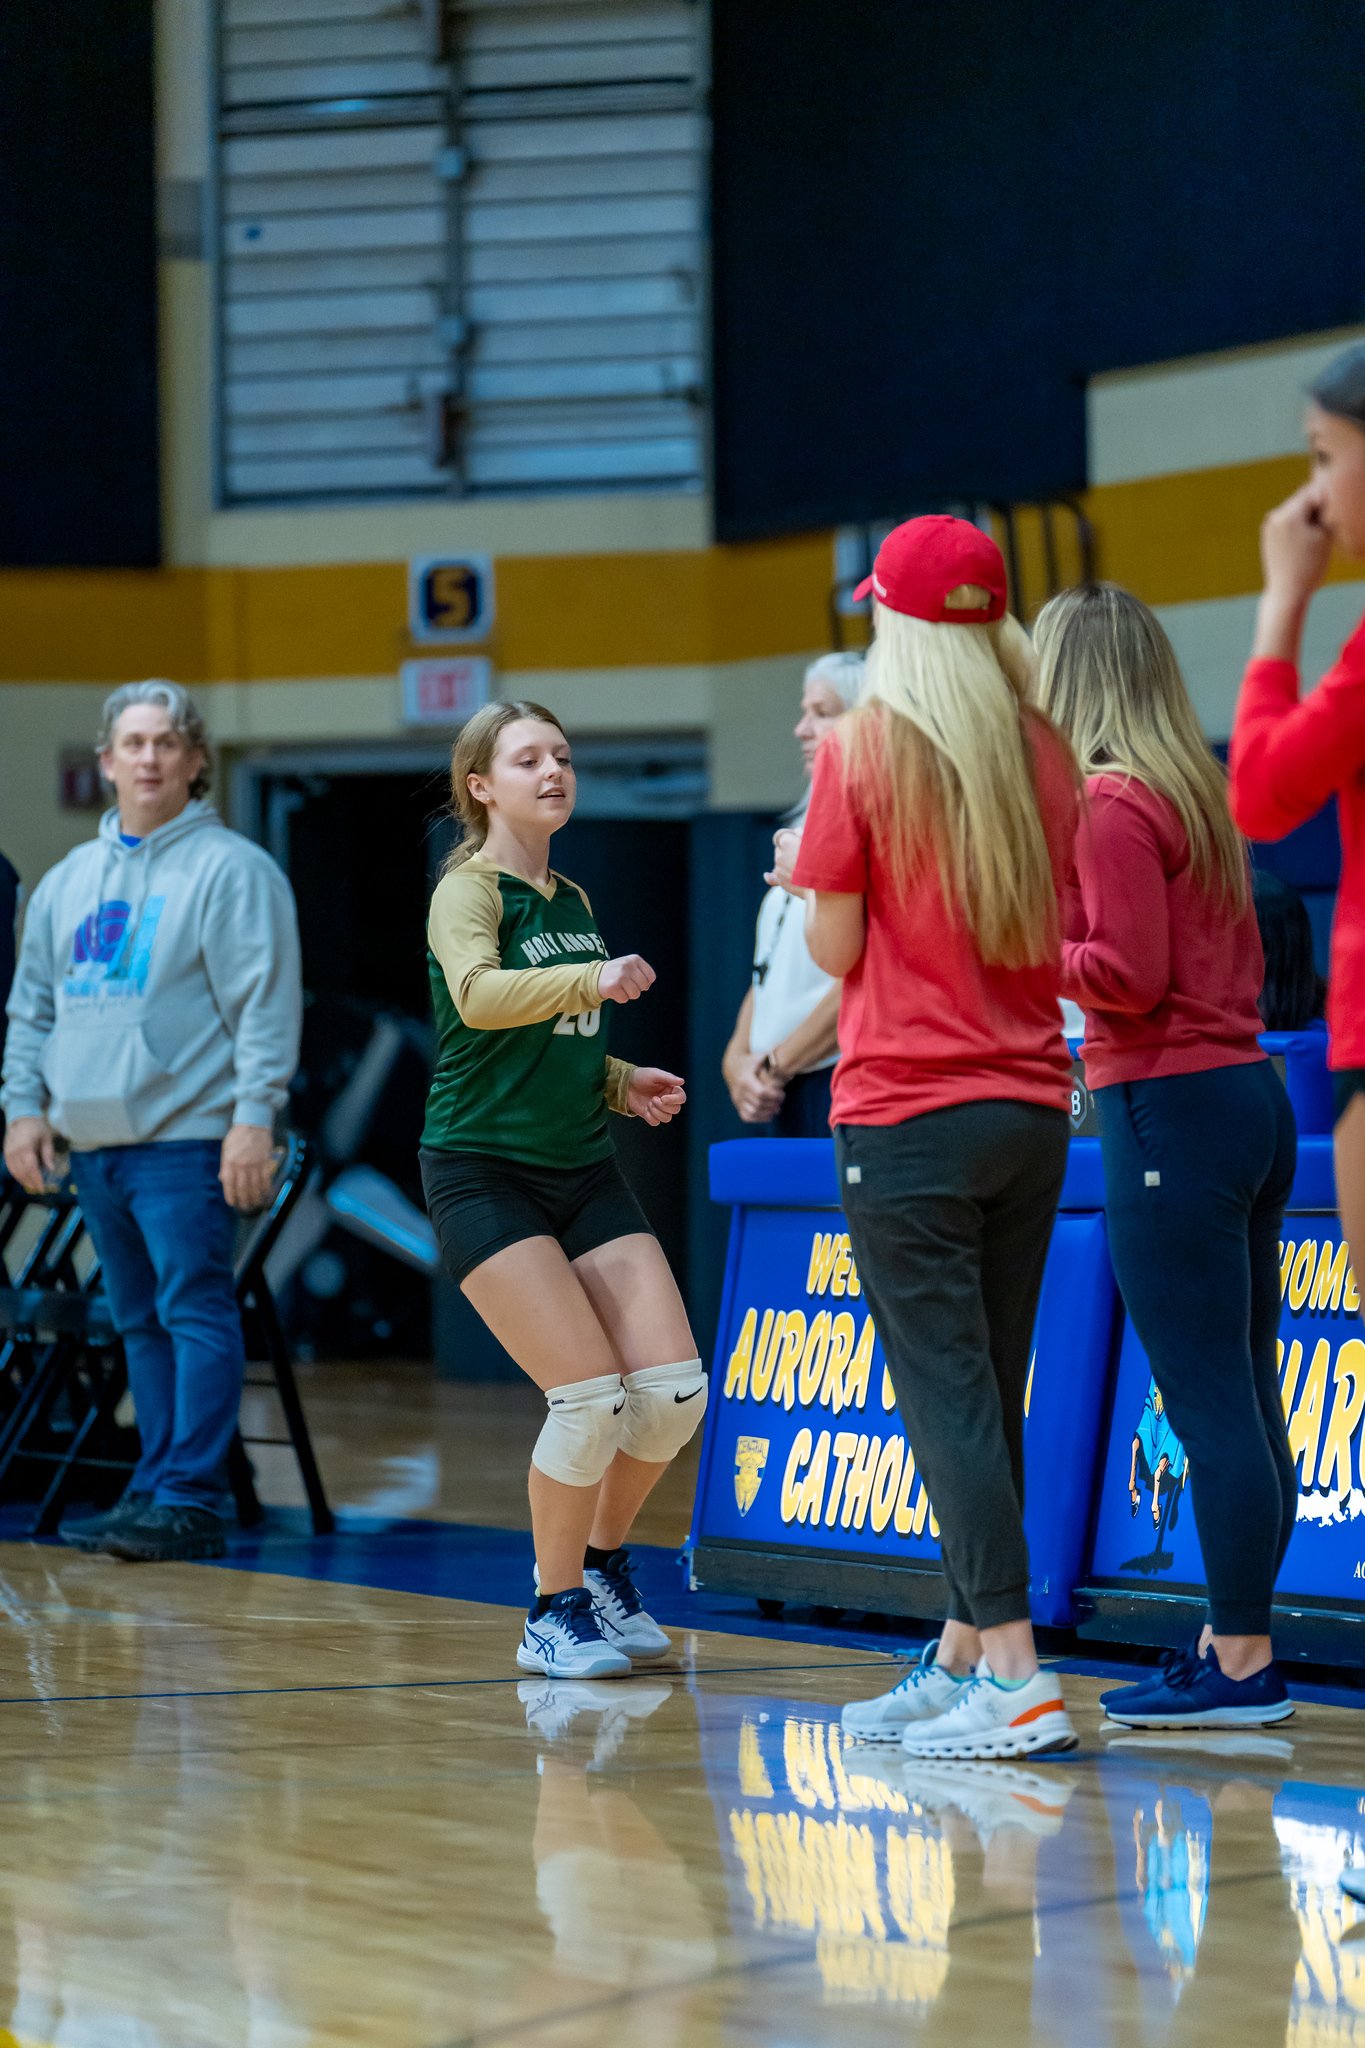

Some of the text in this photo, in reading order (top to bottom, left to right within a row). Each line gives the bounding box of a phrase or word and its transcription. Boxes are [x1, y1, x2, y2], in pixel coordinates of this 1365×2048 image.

[520, 932, 562, 966] HOLY
[806, 1232, 864, 1296] WEL
[723, 1307, 876, 1415] AURORA
[781, 1428, 940, 1538] CATHOLI
